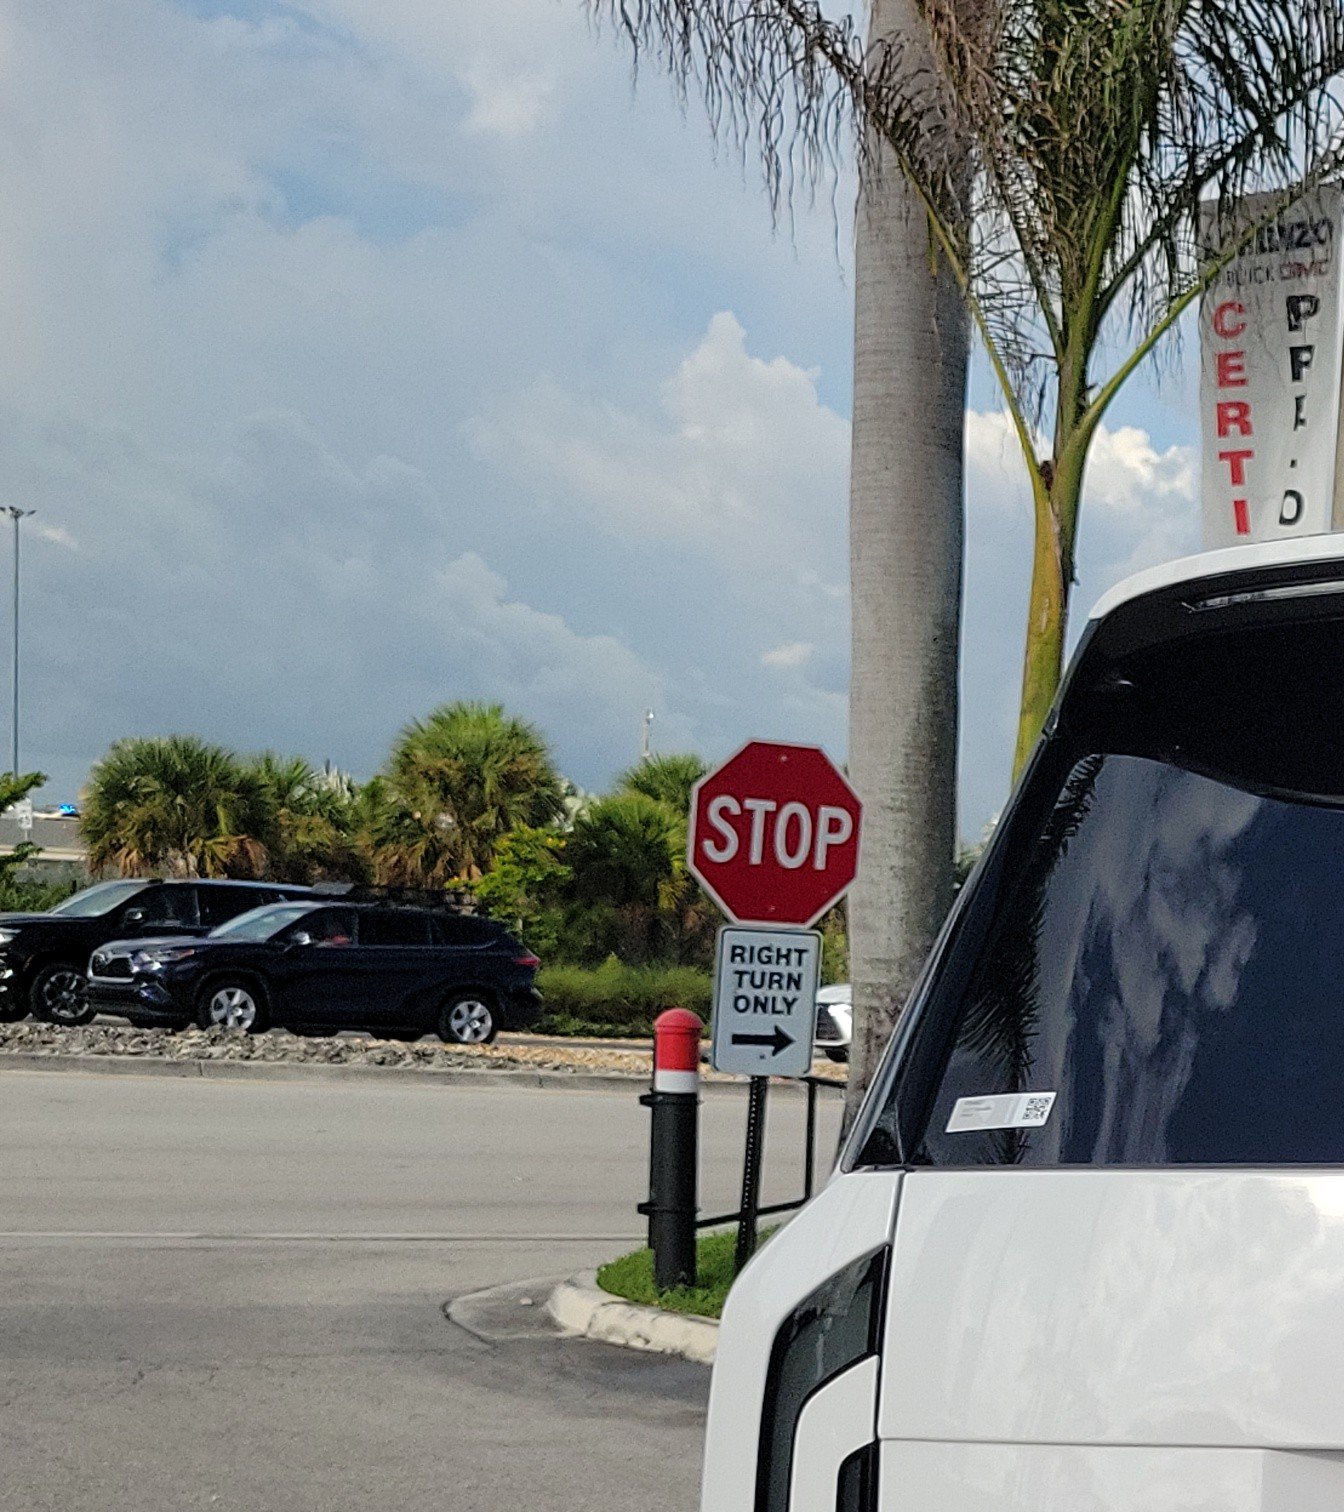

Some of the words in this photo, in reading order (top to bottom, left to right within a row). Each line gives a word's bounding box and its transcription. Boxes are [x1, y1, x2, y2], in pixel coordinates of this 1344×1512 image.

[702, 794, 853, 871] STOP
[730, 944, 810, 968] RIGHT
[734, 969, 804, 991] TURN
[733, 994, 798, 1016] ONLY
